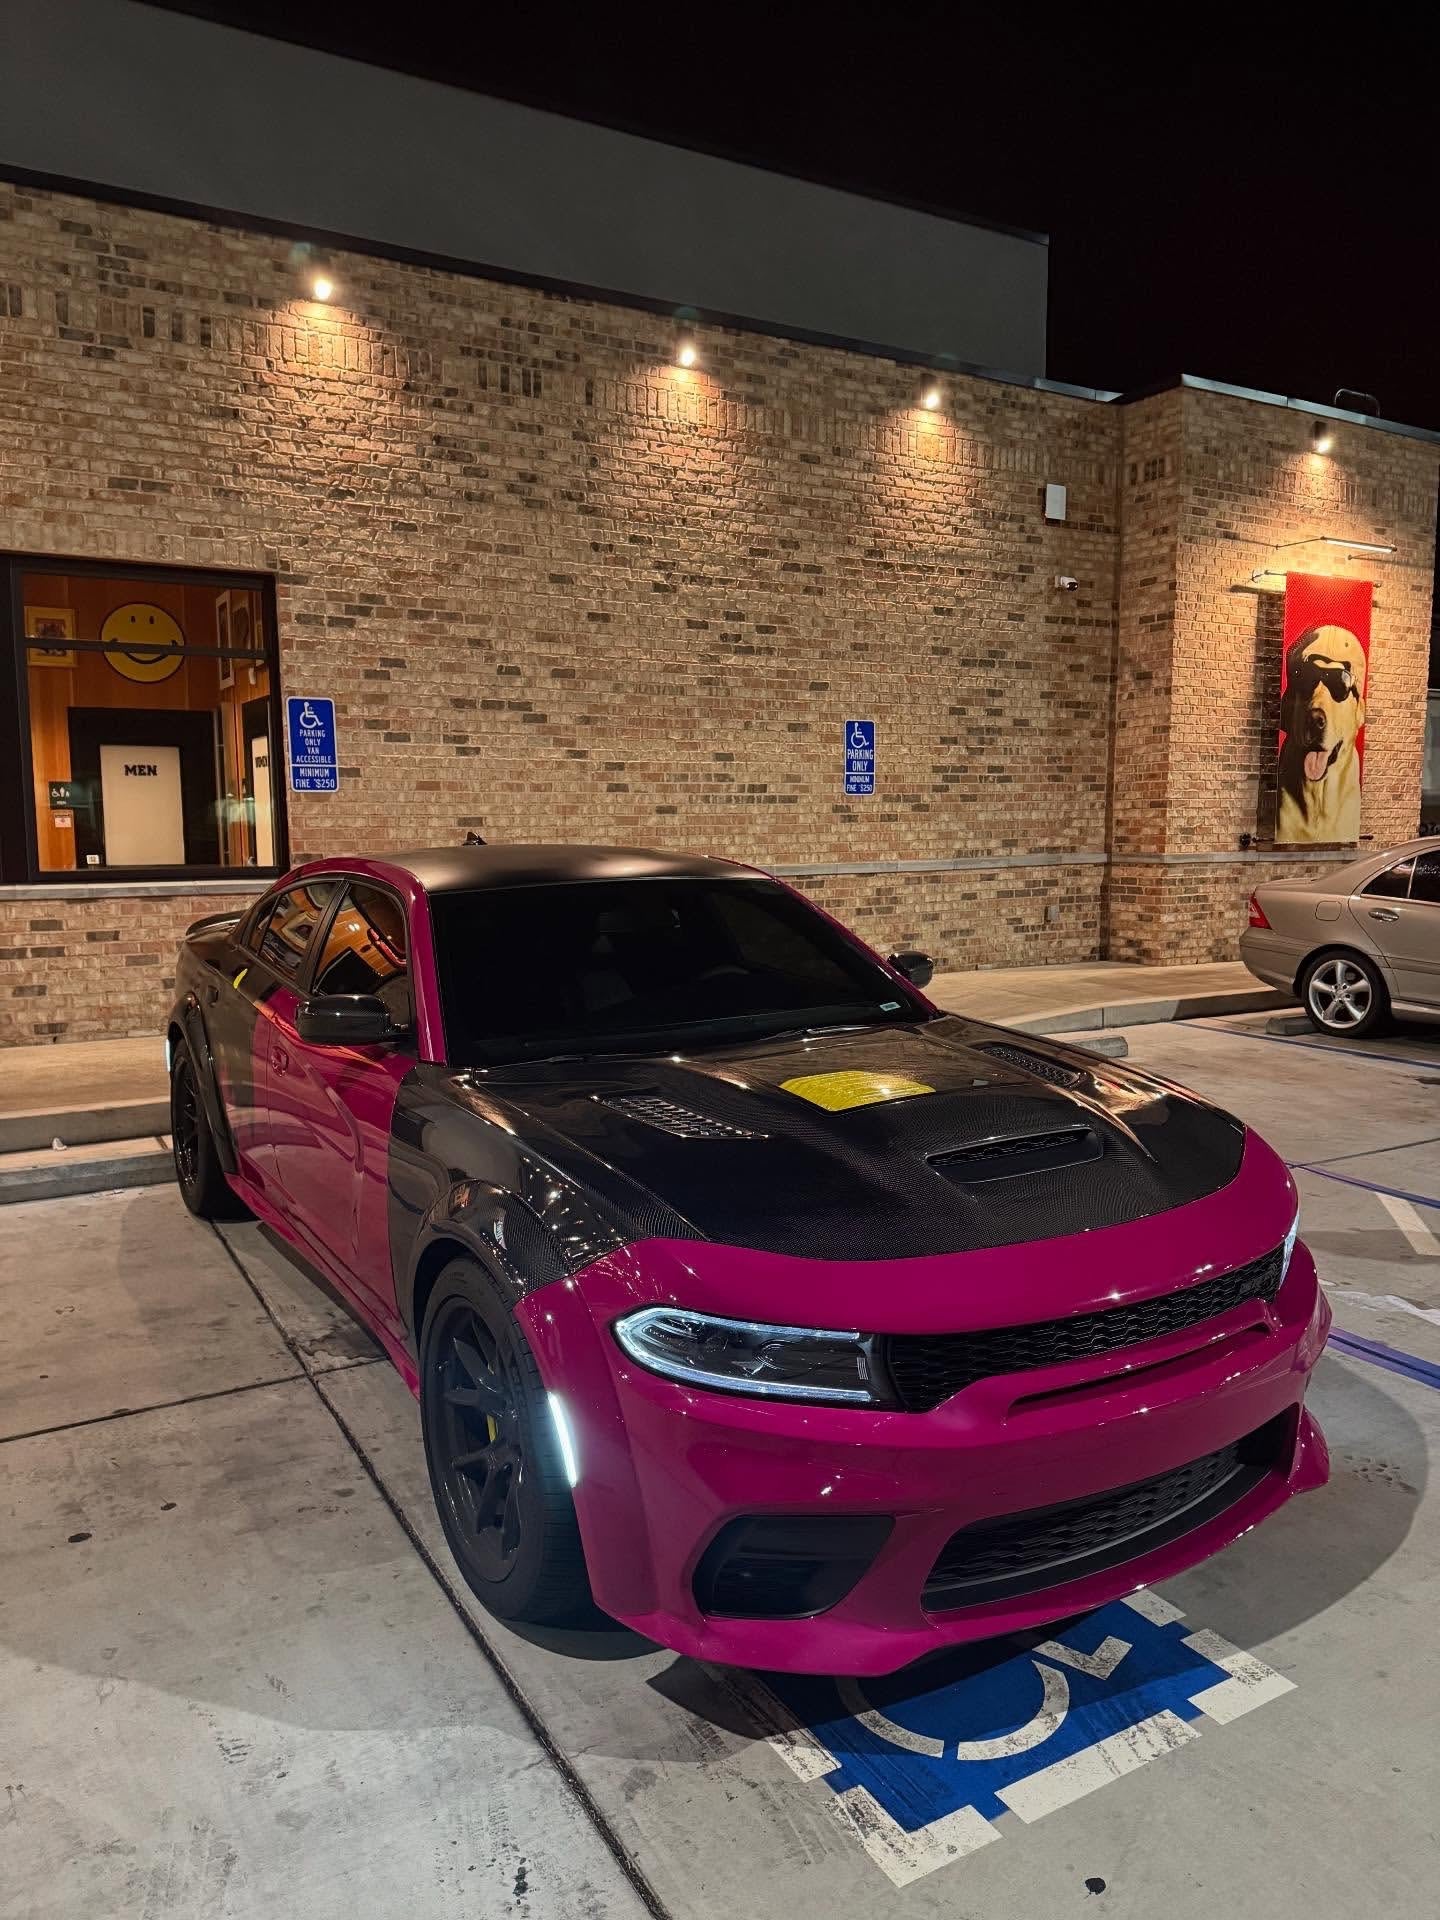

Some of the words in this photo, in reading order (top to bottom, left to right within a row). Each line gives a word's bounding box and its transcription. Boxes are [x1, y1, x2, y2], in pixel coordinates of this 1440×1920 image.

[299, 729, 326, 738] PARKING
[304, 738, 321, 746] ONLY
[307, 747, 320, 755] VAN
[847, 749, 874, 760] PARKING
[296, 755, 332, 764] ACCESSIBLE
[124, 764, 158, 777] MEN
[852, 760, 868, 772] ONLY
[300, 768, 330, 777] MINIMUM
[295, 779, 311, 788] FINE
[314, 779, 335, 789] $250
[846, 784, 857, 792] FINE
[860, 784, 873, 792] $250
